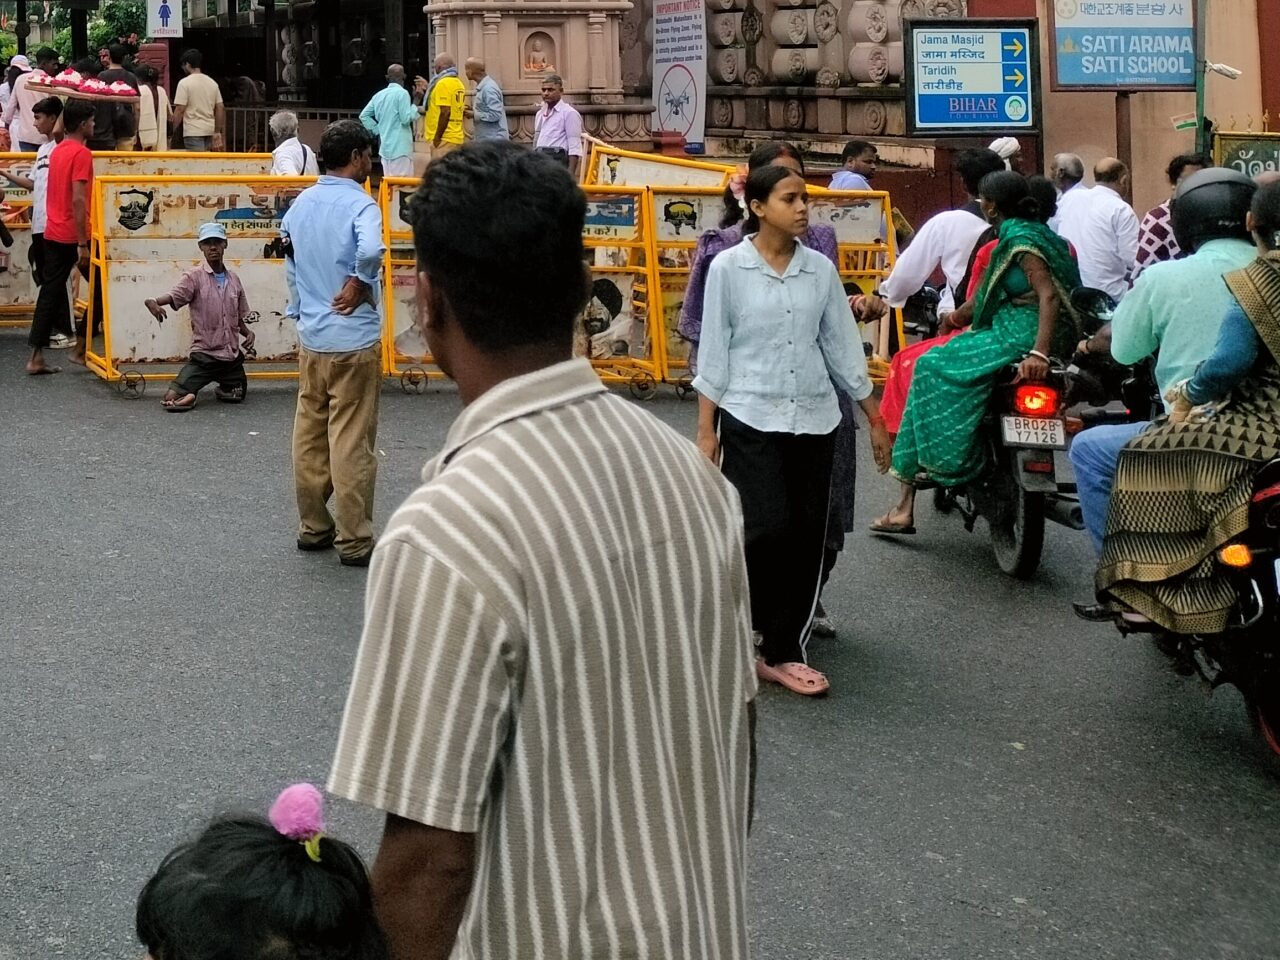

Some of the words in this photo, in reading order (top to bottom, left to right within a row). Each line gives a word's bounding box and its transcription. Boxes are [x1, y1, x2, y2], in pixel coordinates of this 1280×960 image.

[683, 0, 701, 11] NOTICE
[920, 35, 948, 45] Jama
[951, 34, 984, 46] Masjid
[1081, 35, 1125, 53] SATI
[1128, 35, 1194, 53] ARAMA
[921, 50, 947, 59] जामा
[922, 65, 957, 75] Taridih
[1081, 56, 1125, 73] SATI
[1127, 56, 1191, 74] SCHOOL
[948, 97, 997, 111] BIHAR
[1014, 418, 1056, 431] BR02B
